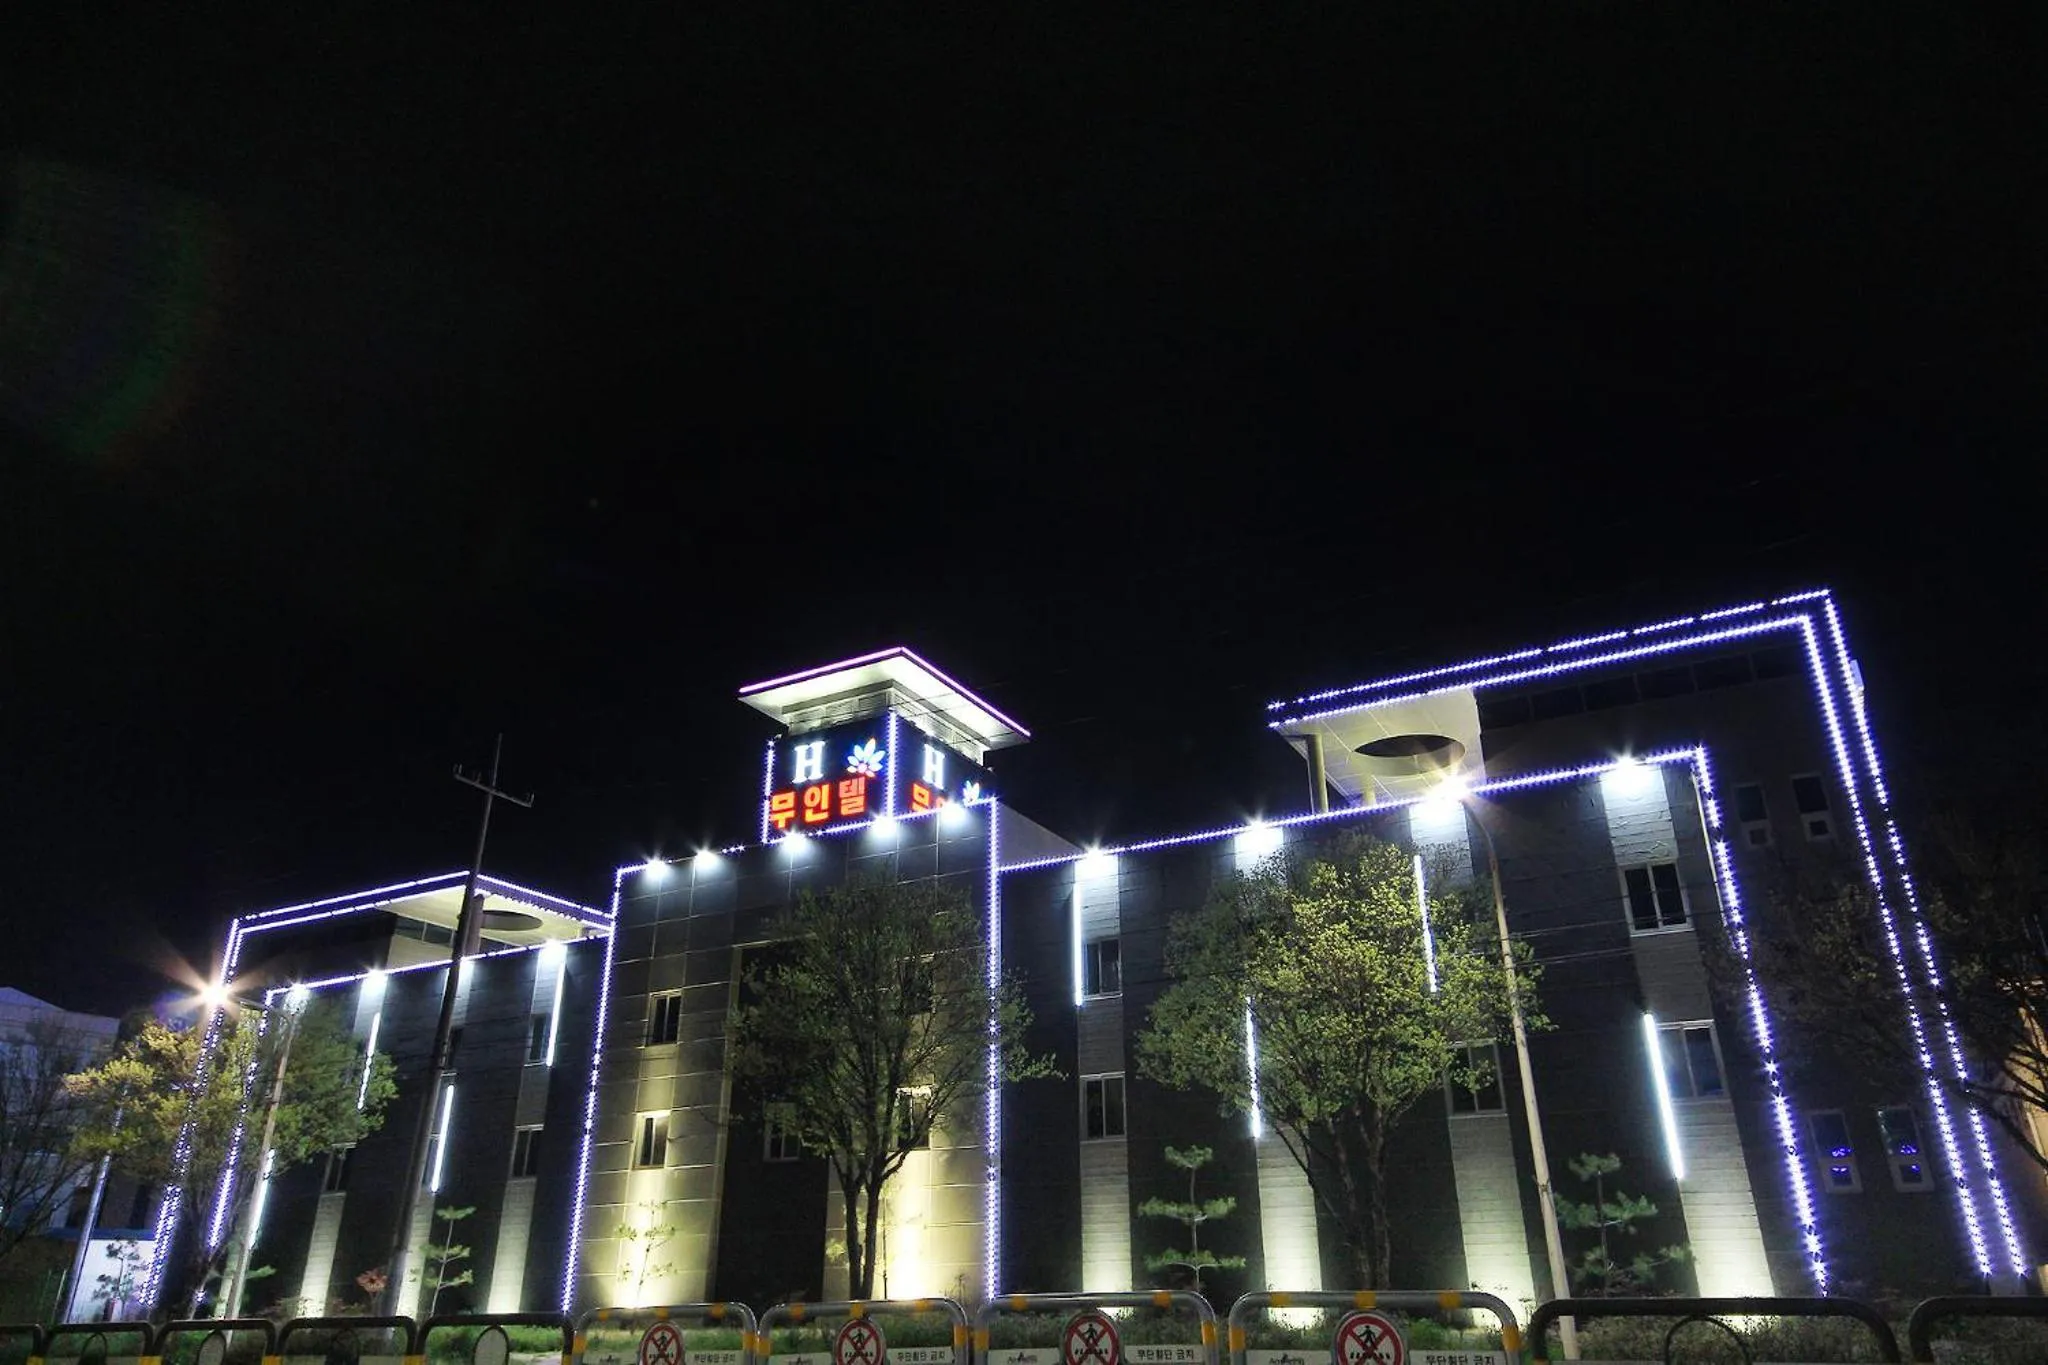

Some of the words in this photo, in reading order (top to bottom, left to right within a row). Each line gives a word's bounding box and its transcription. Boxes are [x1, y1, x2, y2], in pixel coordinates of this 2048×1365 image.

[792, 741, 826, 783] H
[922, 743, 946, 790] H
[770, 775, 866, 830] 무인텔
